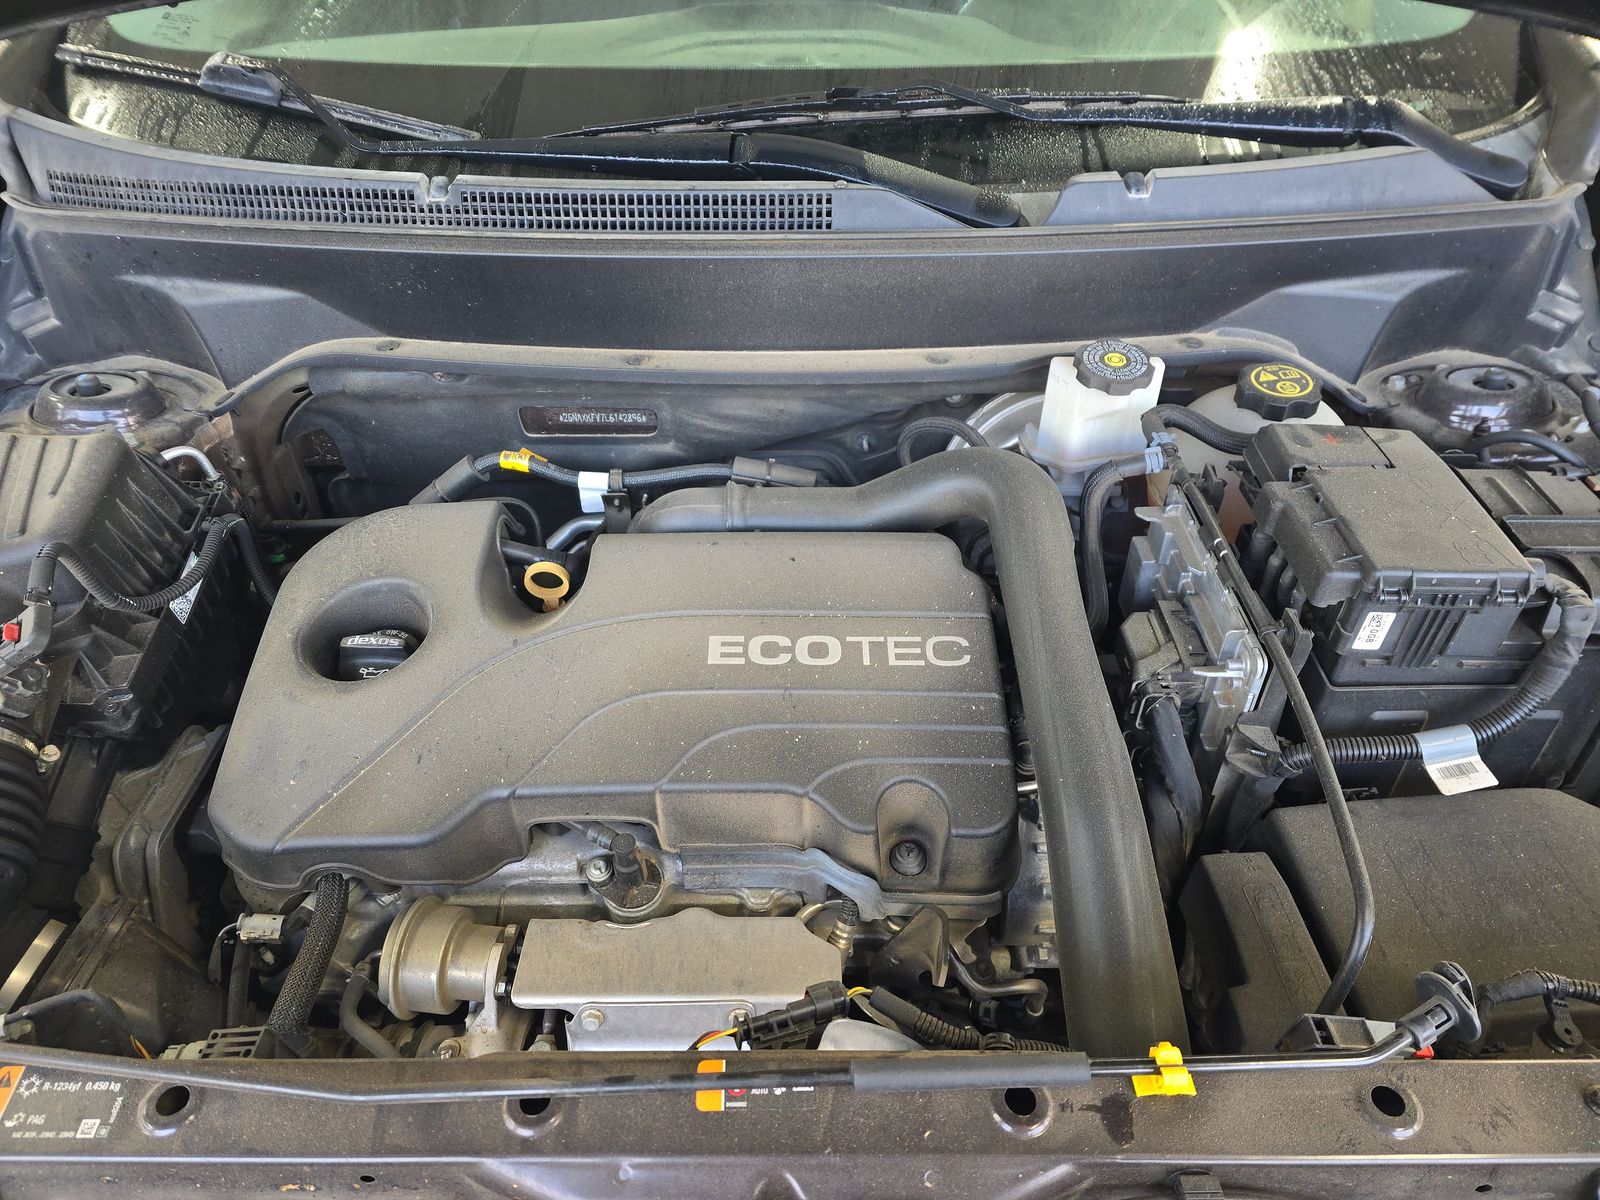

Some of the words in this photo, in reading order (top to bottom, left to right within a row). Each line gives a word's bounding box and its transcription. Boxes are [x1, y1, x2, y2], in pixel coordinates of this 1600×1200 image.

[347, 635, 402, 646] dexos
[707, 635, 971, 667] ECOTEC
[42, 1081, 82, 1093] R-1234yf
[109, 1081, 121, 1093] kg
[26, 1113, 46, 1126] PAG
